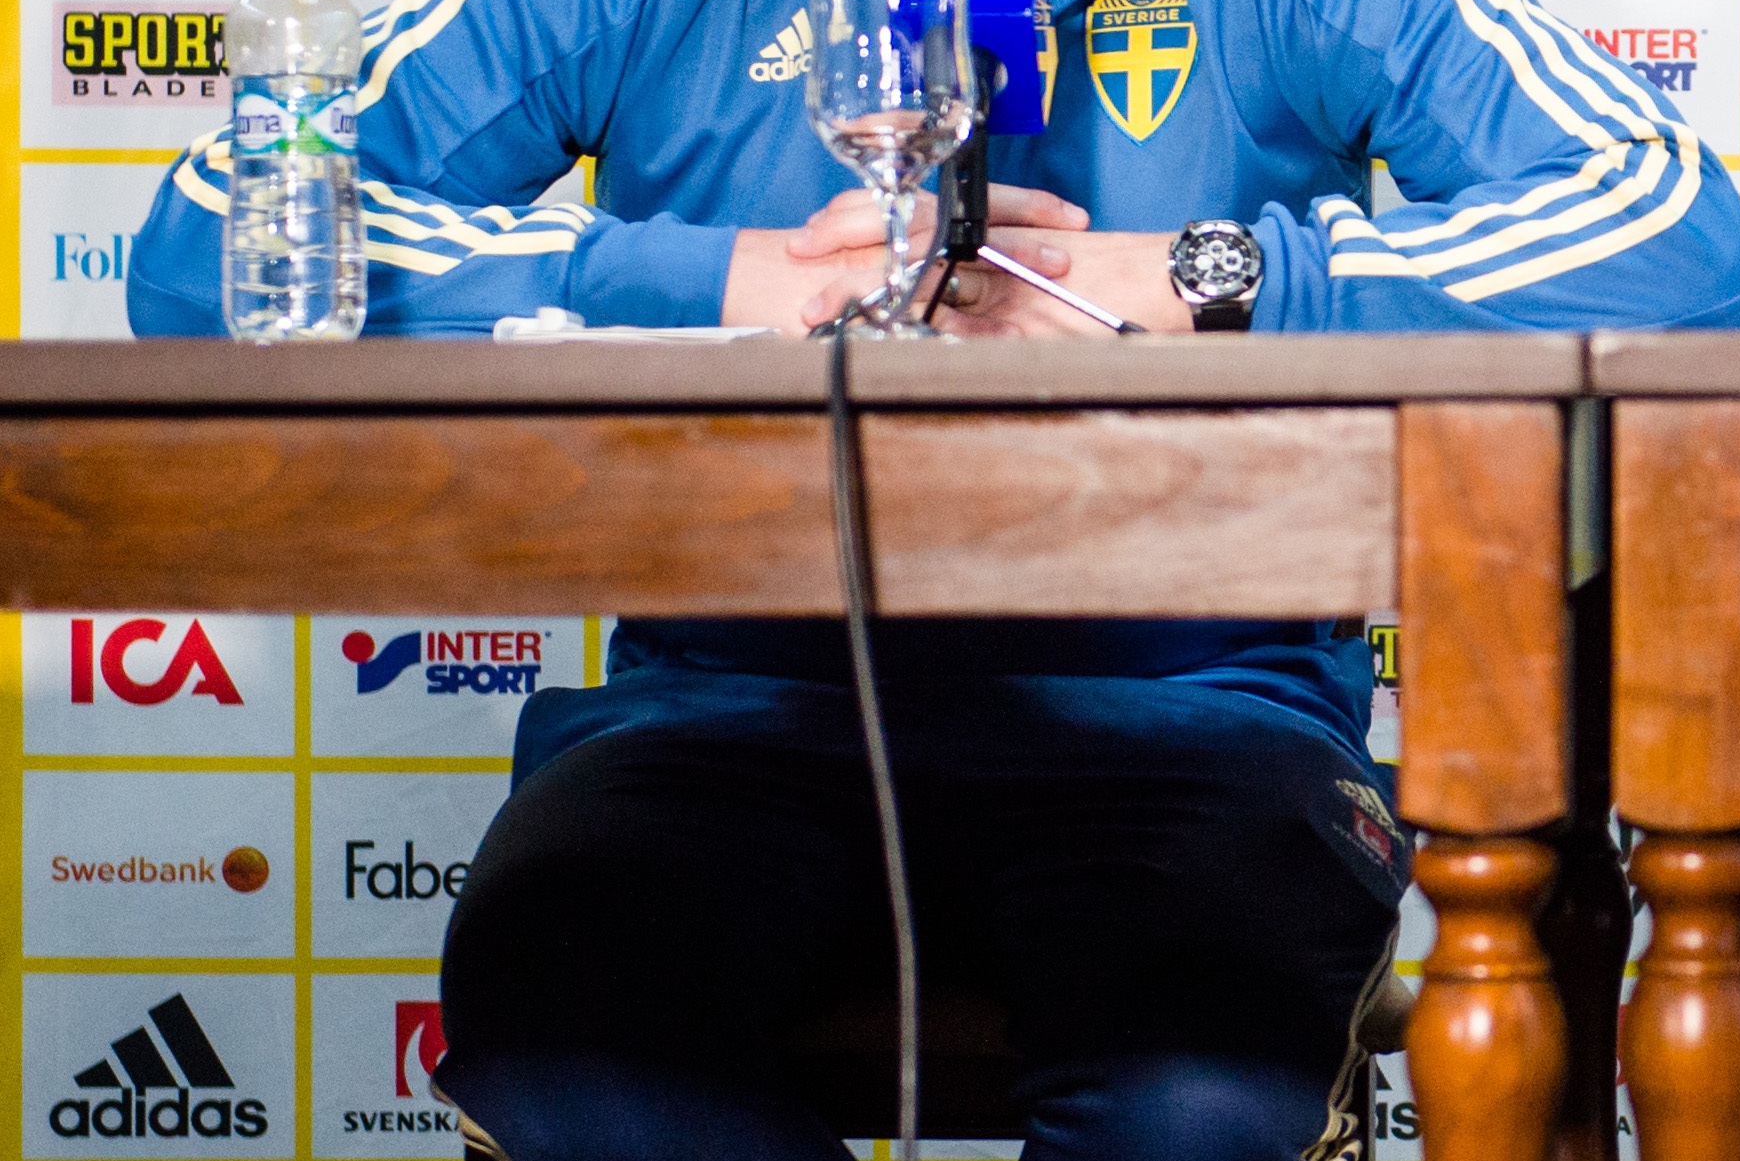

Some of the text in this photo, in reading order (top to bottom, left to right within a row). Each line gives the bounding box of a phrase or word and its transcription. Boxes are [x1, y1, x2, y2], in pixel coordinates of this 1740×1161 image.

[1102, 8, 1180, 28] SVERIGE
[72, 77, 217, 98] BLADE
[427, 631, 541, 661] INTER
[71, 619, 244, 707] ICA
[427, 663, 542, 694] SPORT
[53, 857, 215, 882] Swedbank
[345, 841, 468, 901] Fabe
[49, 1087, 267, 1139] adidas
[343, 1110, 461, 1133] SVENSK
